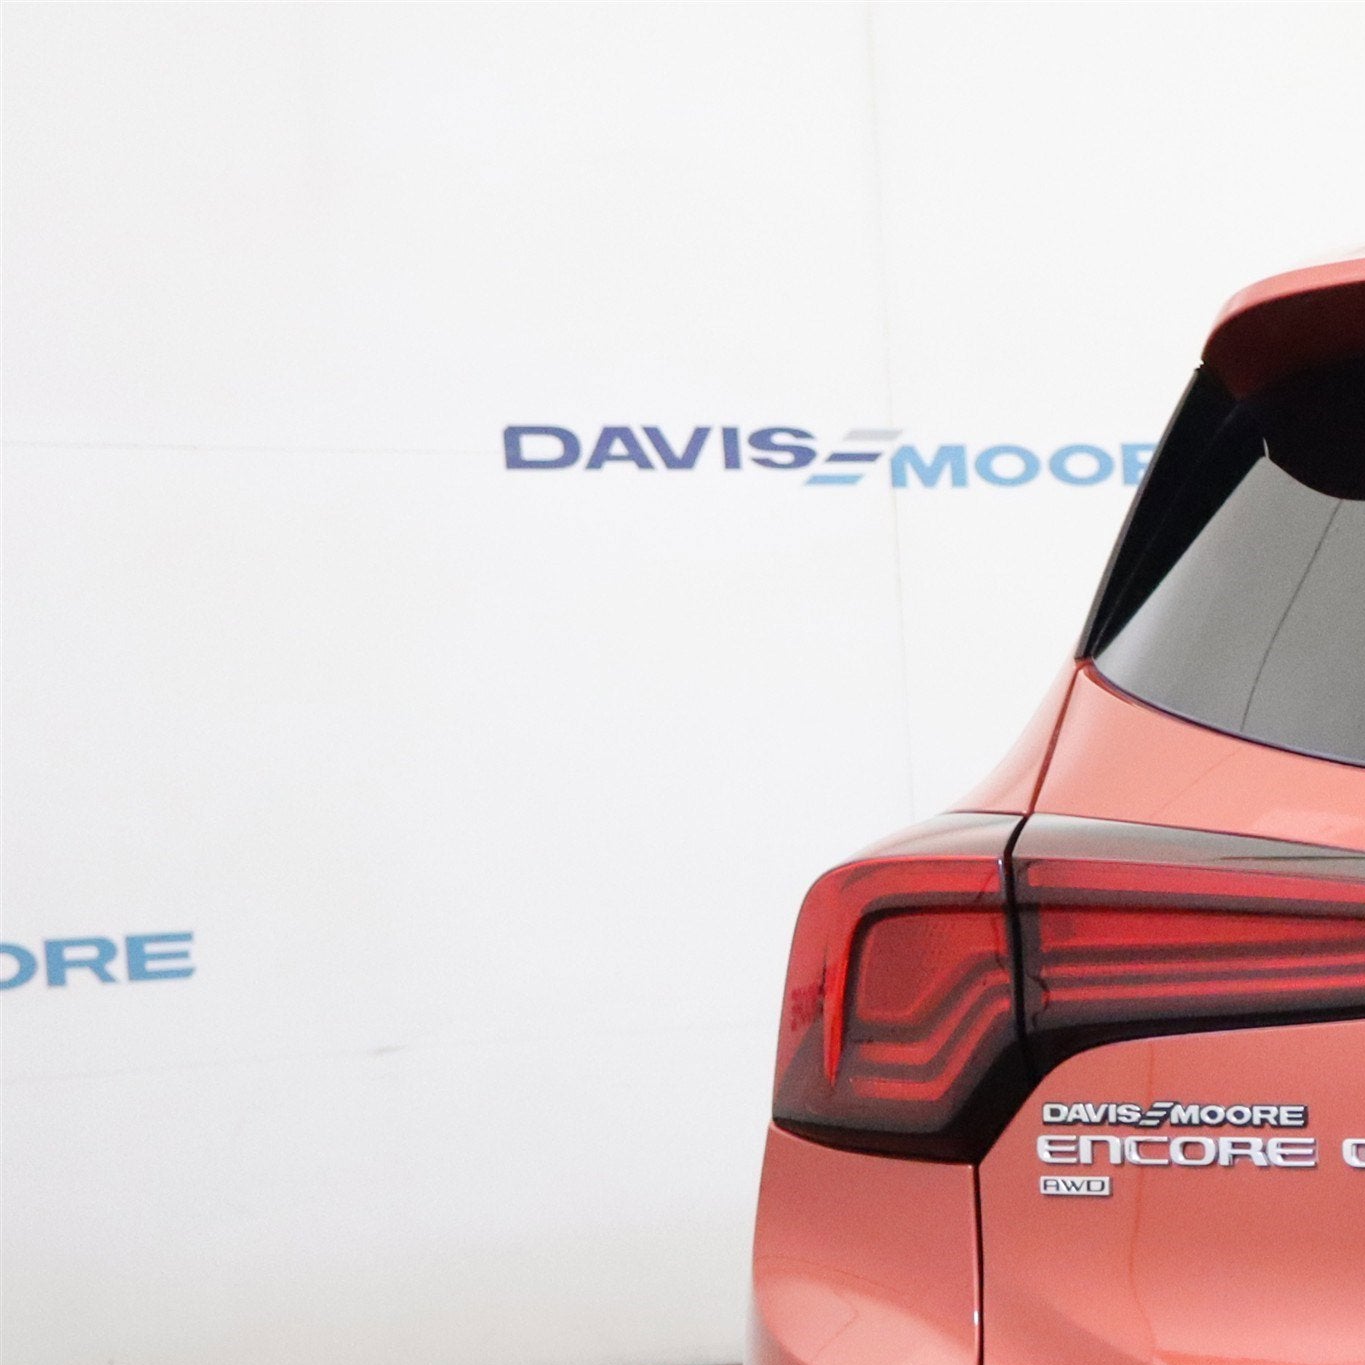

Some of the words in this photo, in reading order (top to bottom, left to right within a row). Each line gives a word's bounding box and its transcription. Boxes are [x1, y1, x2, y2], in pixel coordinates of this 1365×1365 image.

[502, 425, 816, 470] DAVIS
[1041, 1103, 1141, 1125] DAVIS
[1170, 1104, 1307, 1126] MOORE
[1037, 1135, 1318, 1168] ENCORE
[1042, 1178, 1107, 1194] AWD
